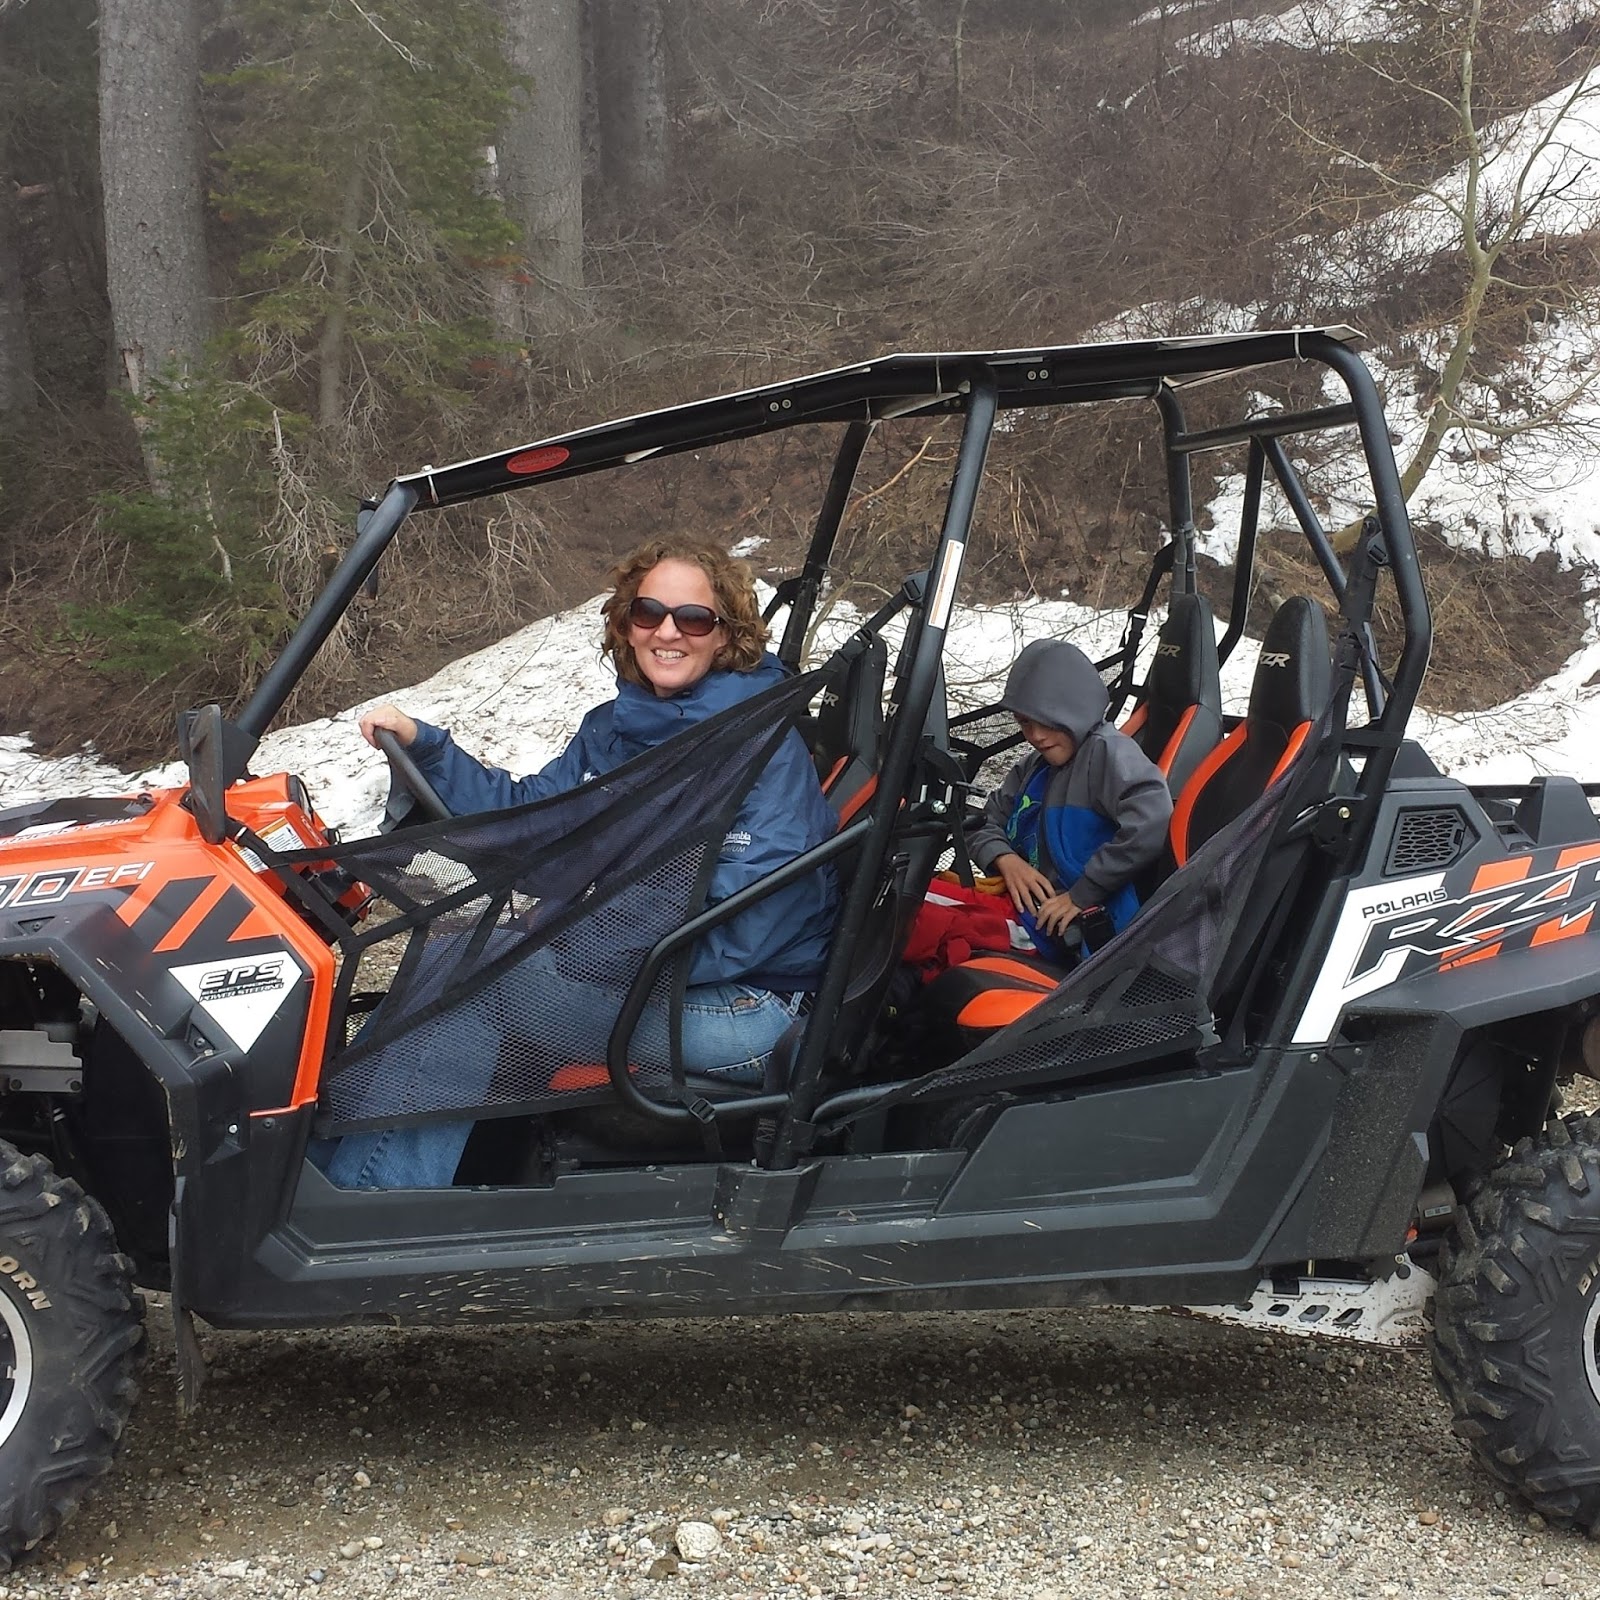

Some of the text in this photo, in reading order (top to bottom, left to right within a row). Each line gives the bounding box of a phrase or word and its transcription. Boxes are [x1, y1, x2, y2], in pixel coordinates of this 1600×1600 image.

[81, 861, 155, 887] EFI
[1361, 887, 1447, 919] POLARIS
[199, 960, 284, 990] EPS
